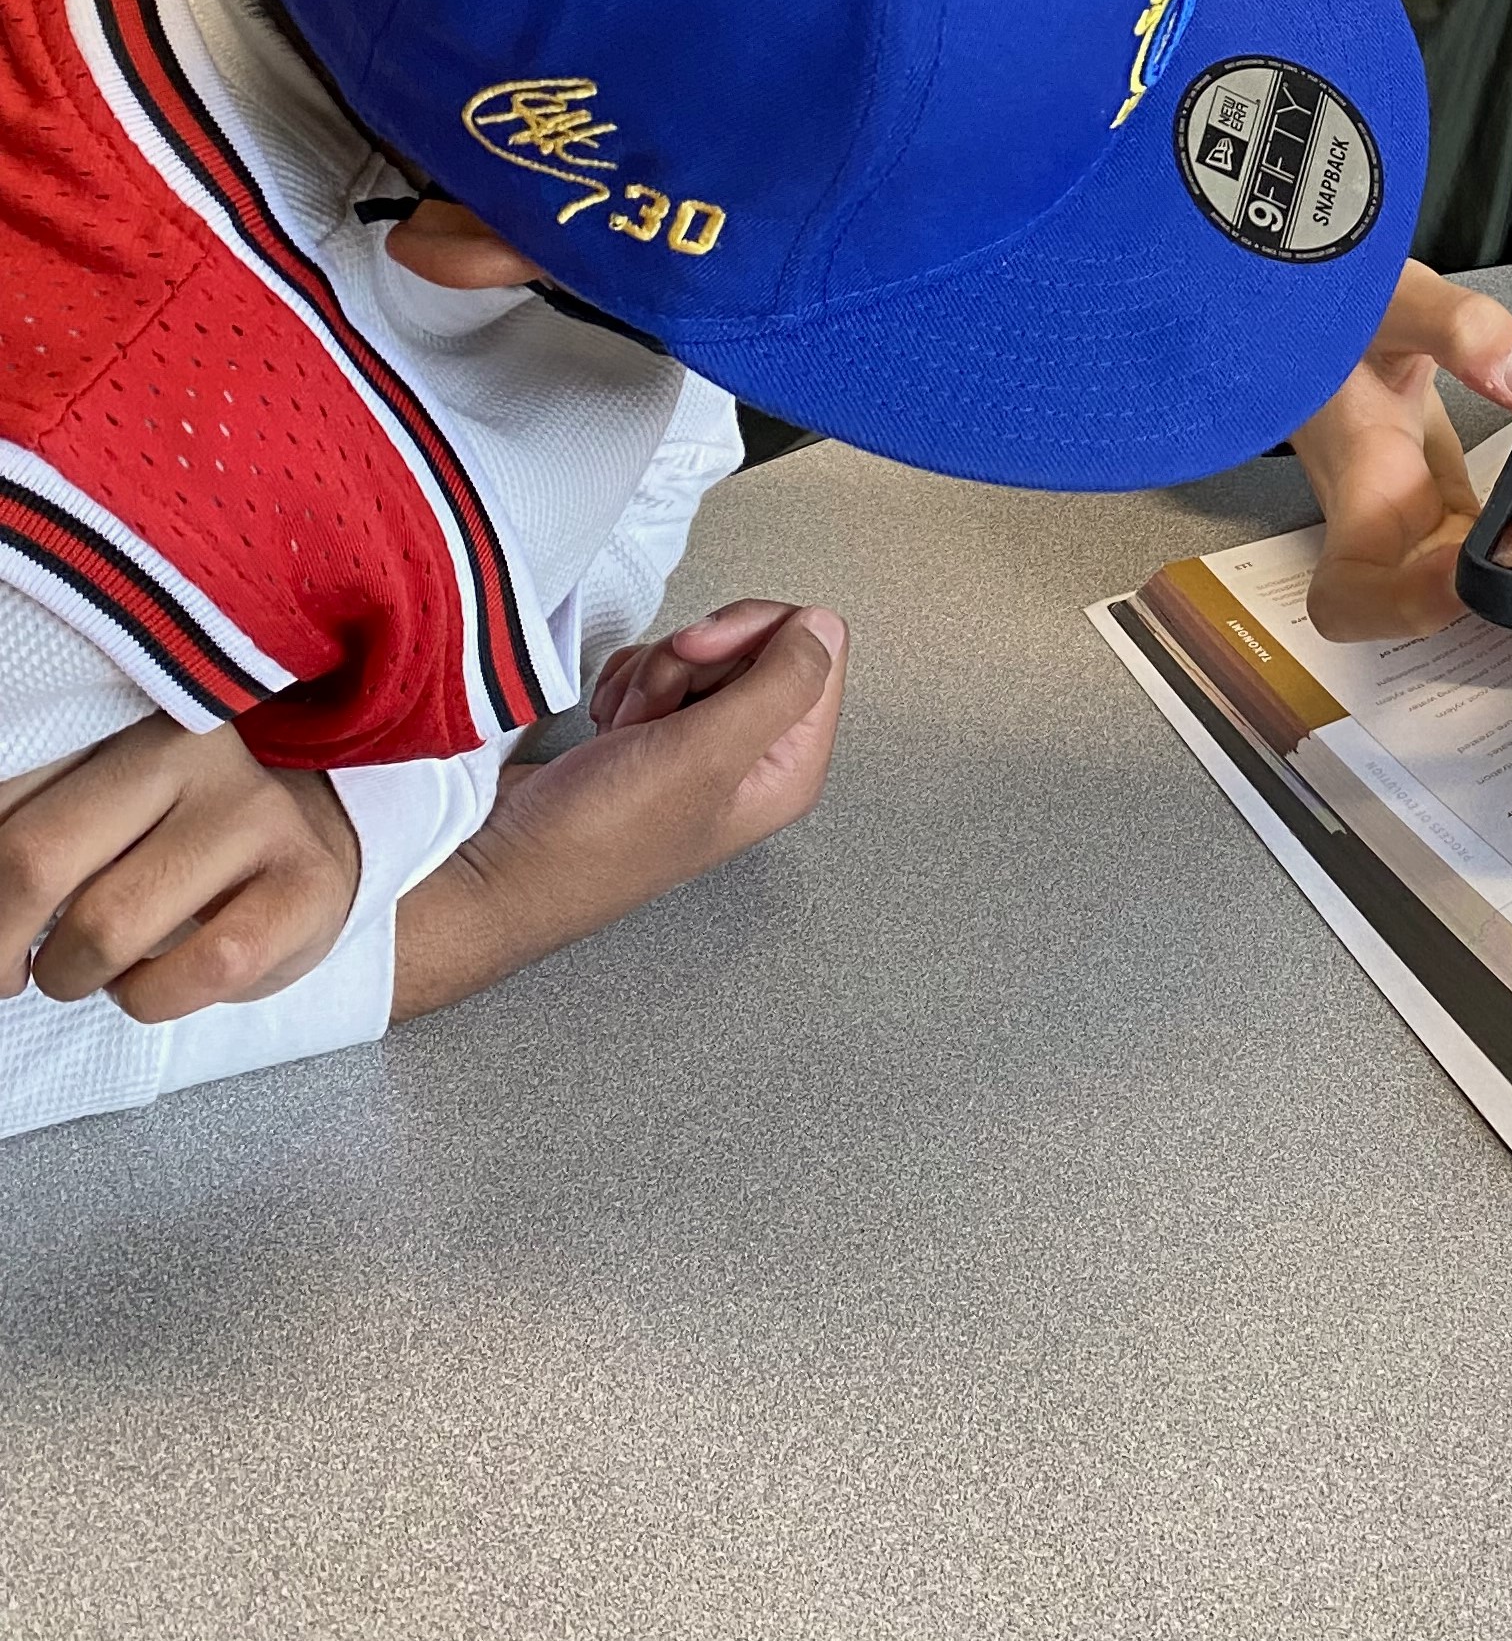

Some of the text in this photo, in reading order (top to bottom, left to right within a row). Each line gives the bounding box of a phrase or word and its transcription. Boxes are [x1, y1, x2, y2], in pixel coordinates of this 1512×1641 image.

[1219, 94, 1238, 127] NEW
[1231, 100, 1250, 133] ERA
[1248, 87, 1313, 234] 9FIFTY
[1312, 136, 1351, 227] SNAPBACK
[609, 183, 727, 256] 30
[1222, 615, 1275, 664] TAXONOMY
[1363, 758, 1475, 864] PROCESS OF EVOLUTION
